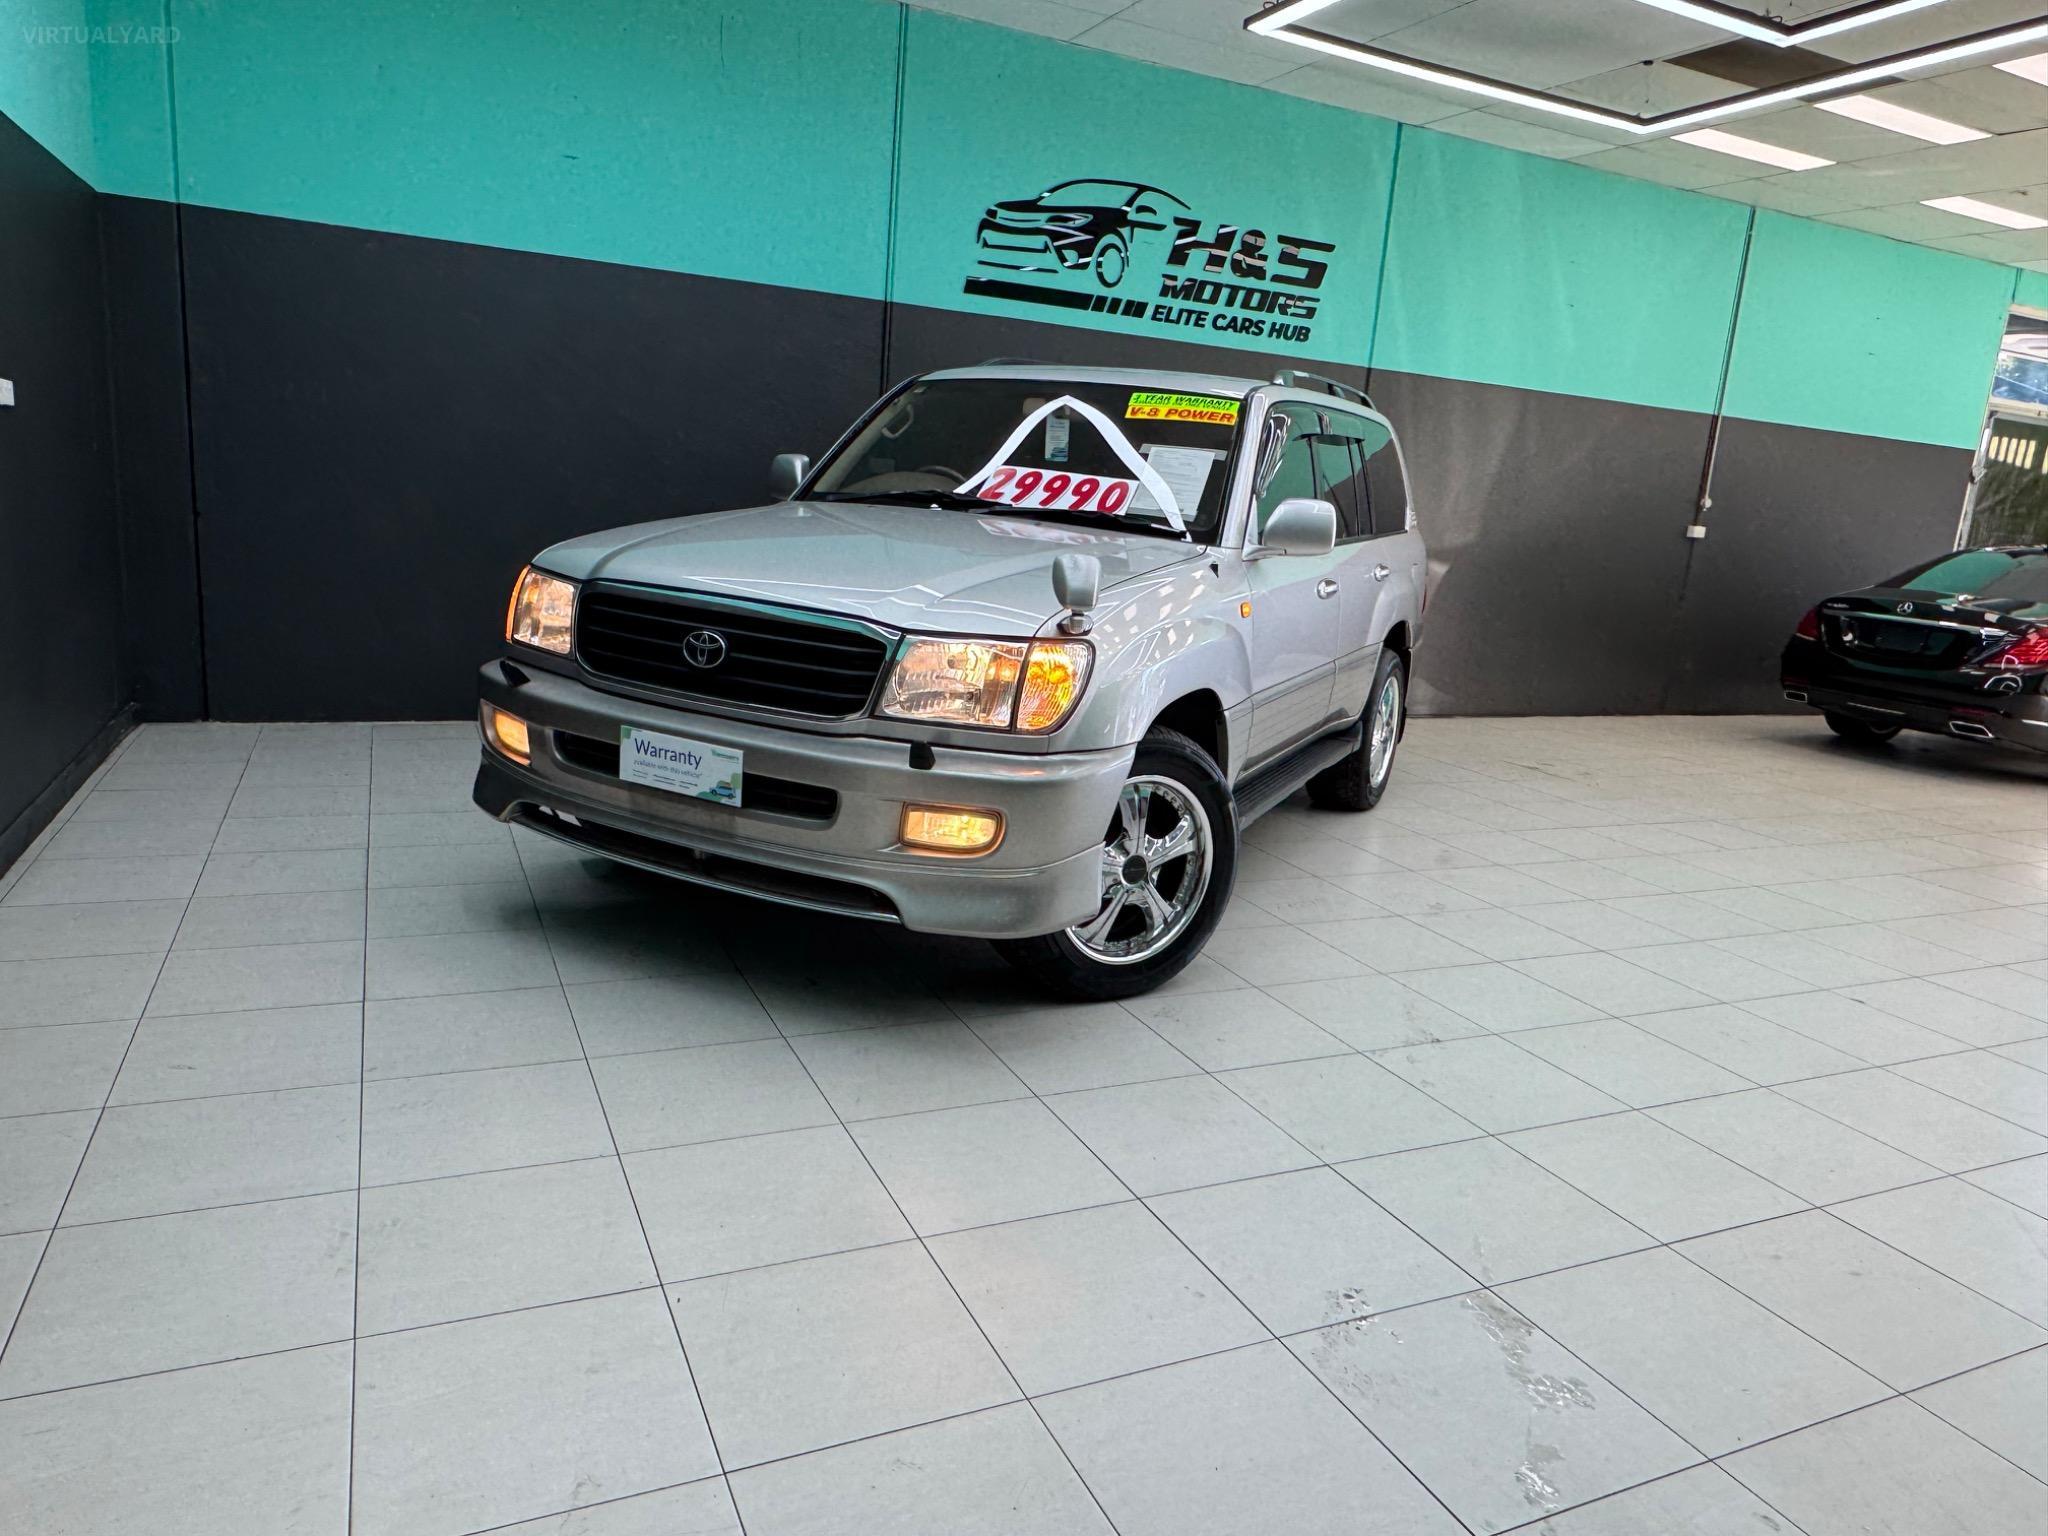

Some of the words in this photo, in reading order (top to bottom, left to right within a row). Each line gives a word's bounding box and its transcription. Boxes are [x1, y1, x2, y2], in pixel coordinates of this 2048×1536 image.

[1165, 216, 1336, 289] H&S
[1158, 273, 1322, 319] MOTORS
[1150, 304, 1208, 328] ELITE
[1211, 313, 1264, 337] CARS
[1267, 322, 1311, 342] HUB
[1130, 407, 1160, 417] V-8
[1164, 408, 1235, 423] POWER
[1145, 394, 1170, 402] YEAR
[1175, 396, 1236, 407] WARRANTY
[978, 467, 1130, 513] 29990
[634, 738, 702, 770] Warranty
